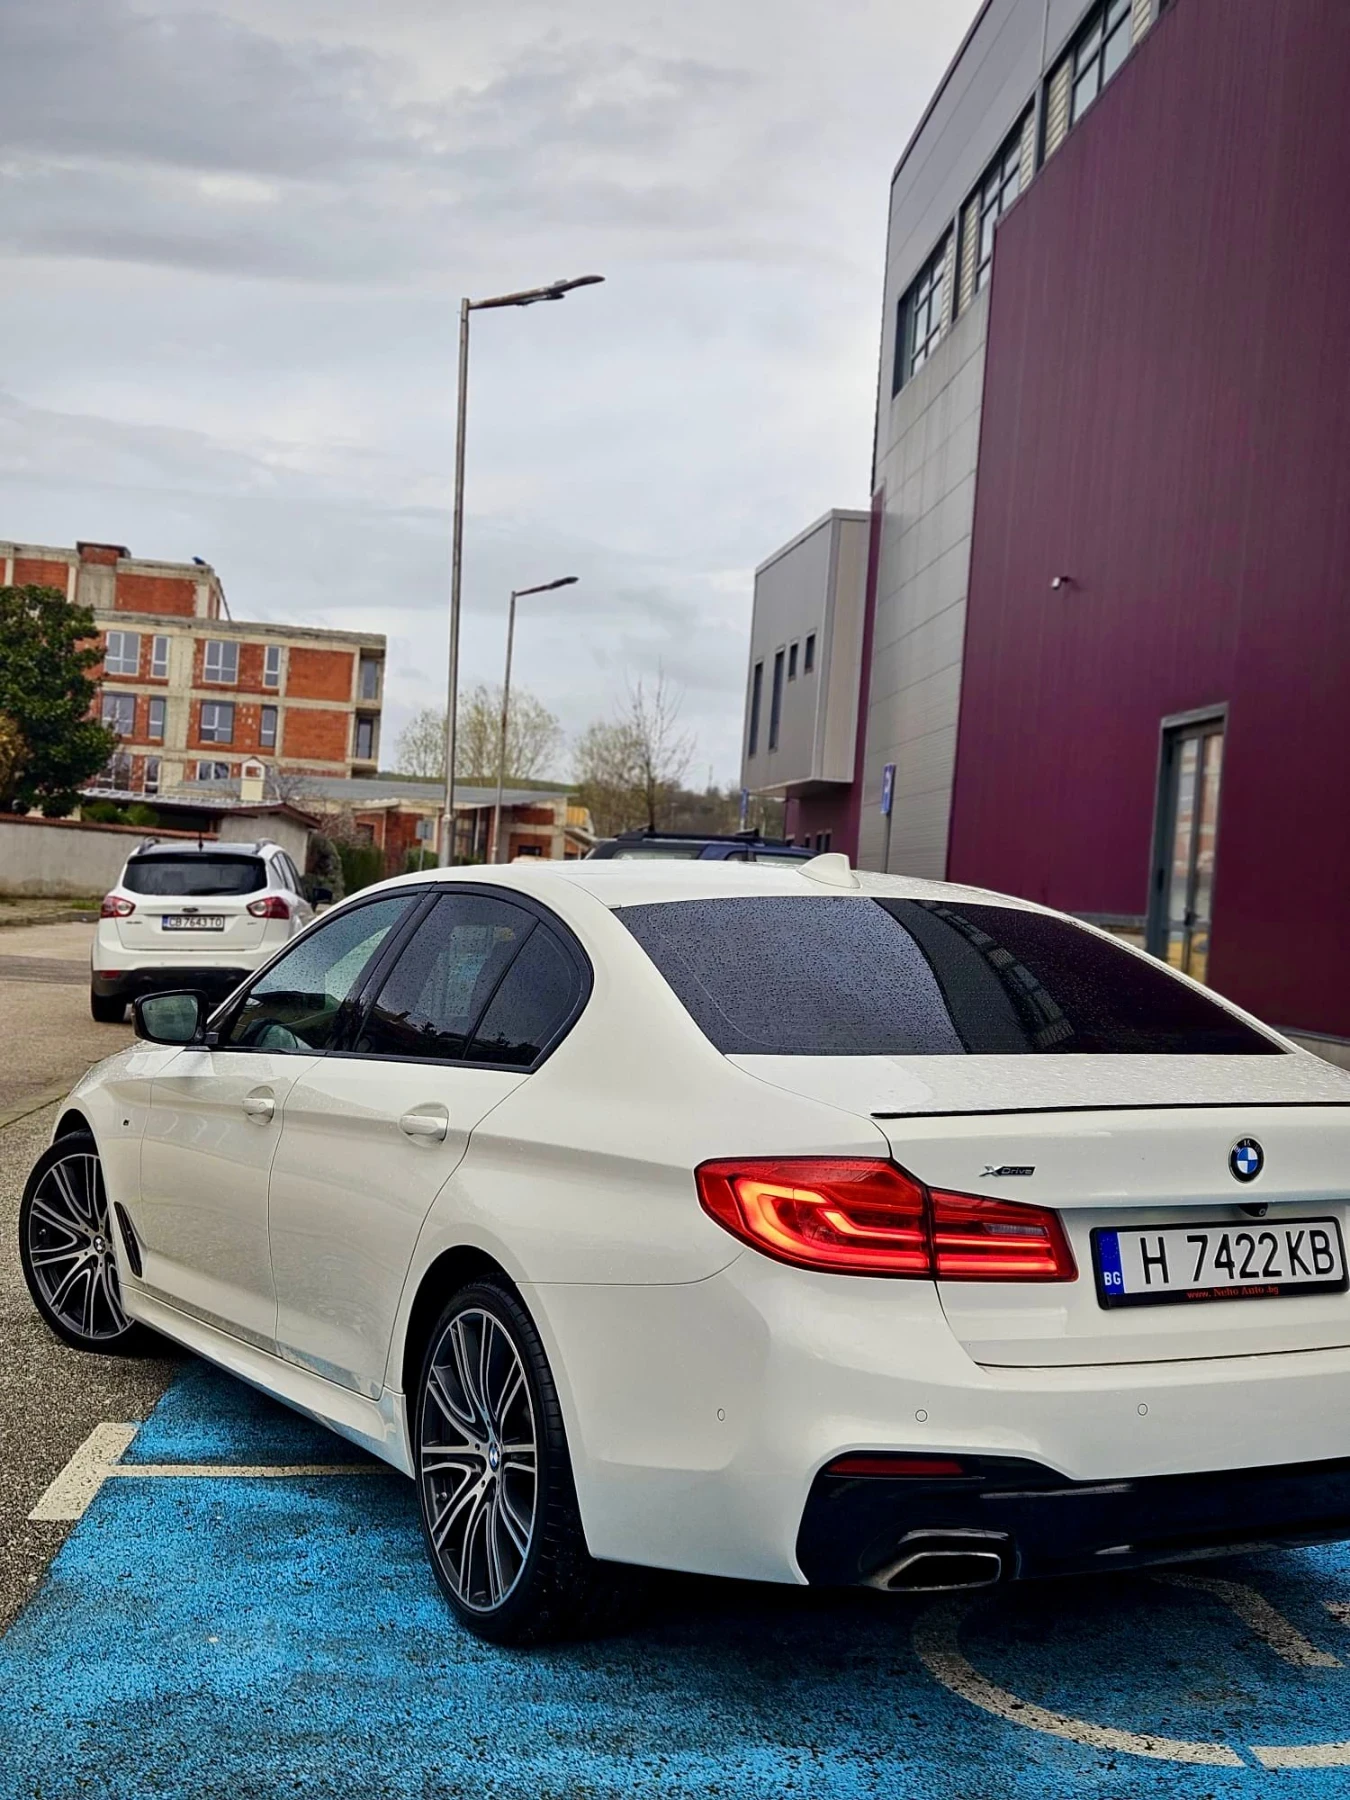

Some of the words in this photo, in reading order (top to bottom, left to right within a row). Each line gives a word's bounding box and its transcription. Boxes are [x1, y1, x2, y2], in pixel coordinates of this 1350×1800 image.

[169, 917, 182, 927] CB
[184, 917, 207, 927] 7643
[1140, 1236, 1170, 1285] H
[1187, 1232, 1282, 1283] 7422
[1103, 1271, 1122, 1286] BG
